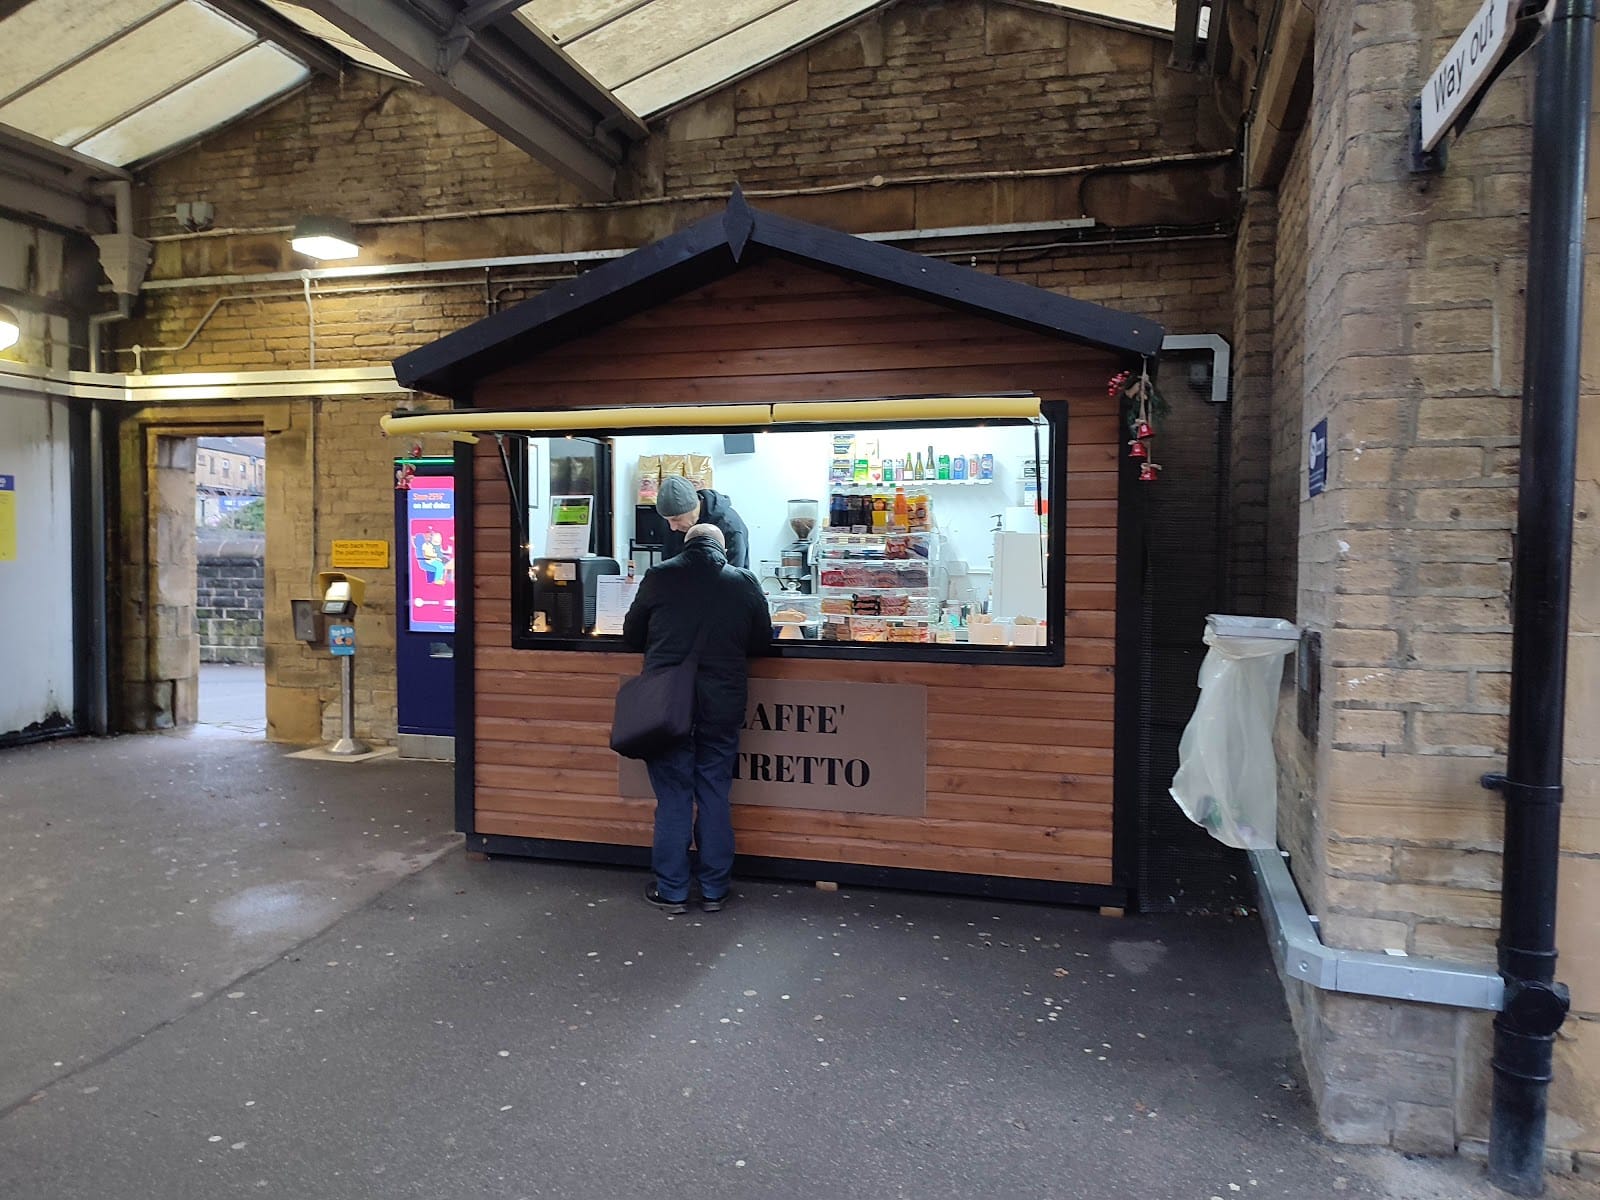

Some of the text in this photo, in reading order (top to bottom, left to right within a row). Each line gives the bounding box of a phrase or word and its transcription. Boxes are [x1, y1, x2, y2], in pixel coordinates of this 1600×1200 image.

[1433, 4, 1495, 113] Way out
[739, 703, 846, 735] AFFE'
[732, 752, 871, 788] TRETTO
